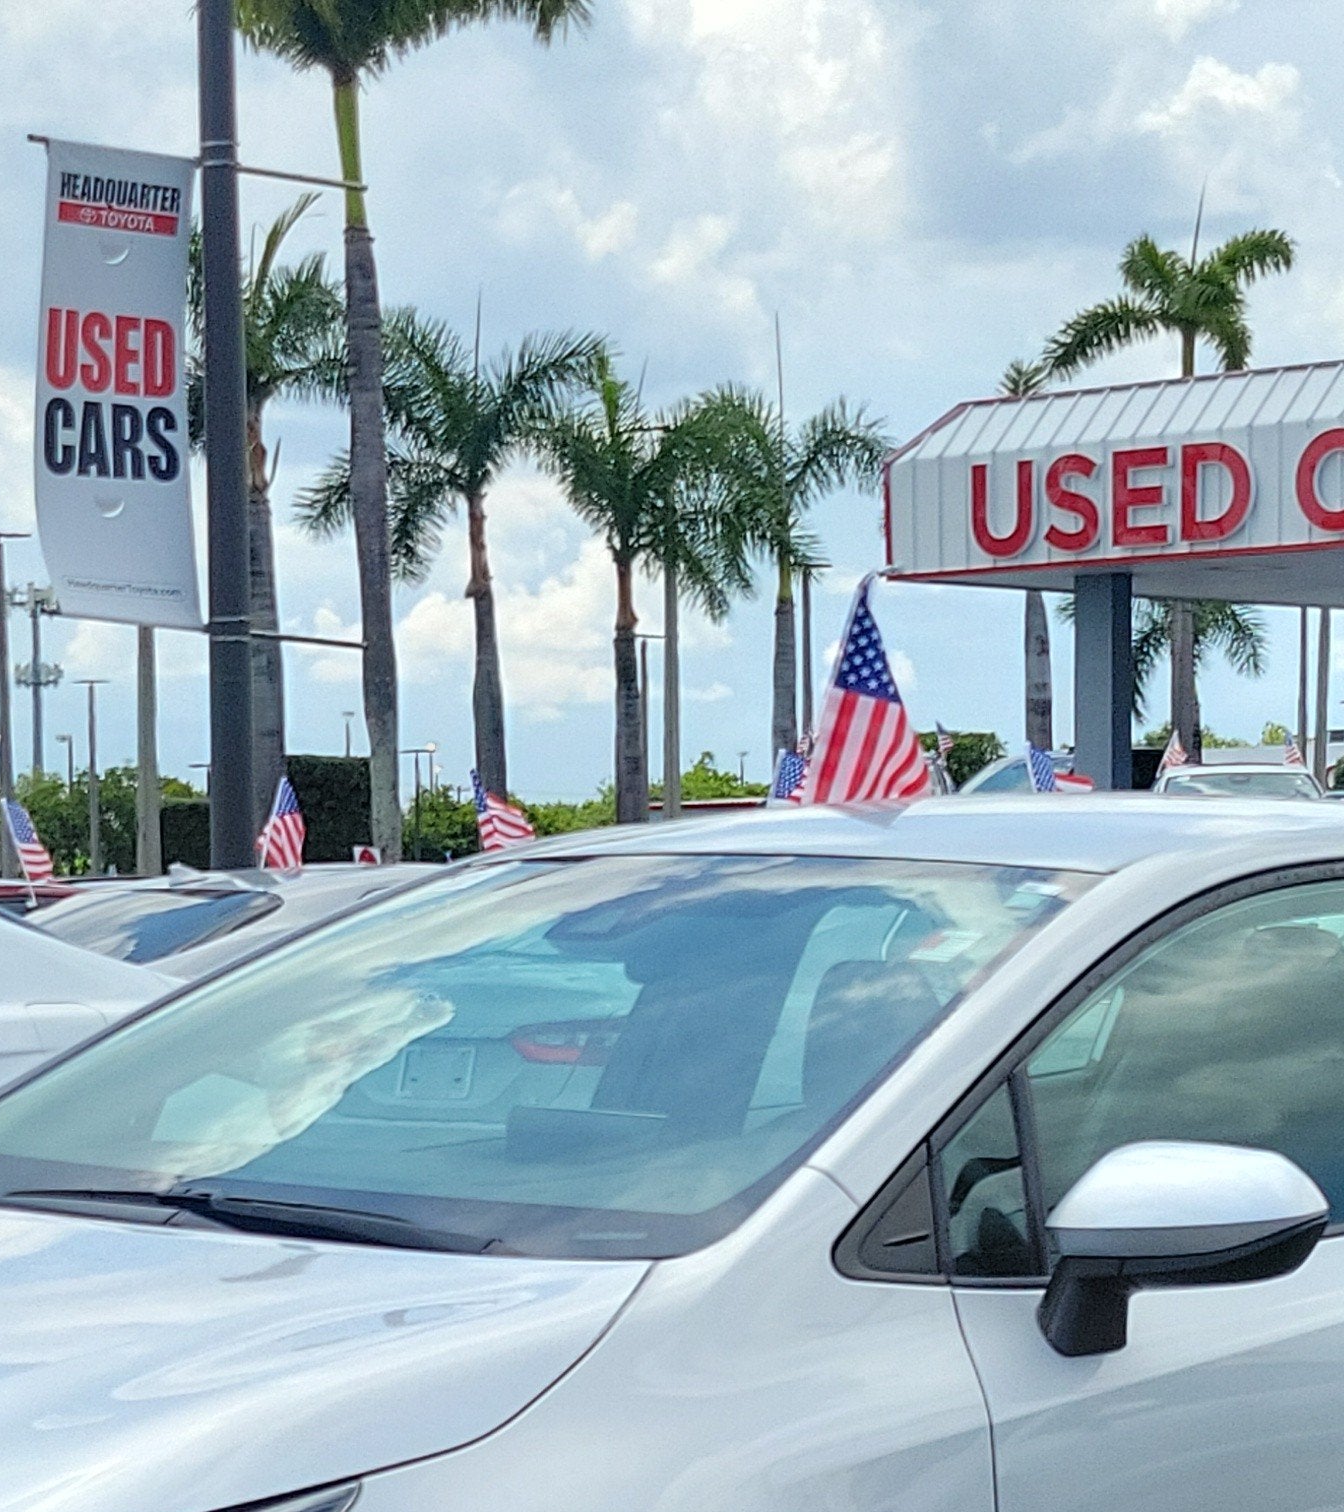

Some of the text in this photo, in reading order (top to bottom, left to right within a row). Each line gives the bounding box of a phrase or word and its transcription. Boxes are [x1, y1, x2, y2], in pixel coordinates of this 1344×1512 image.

[59, 171, 181, 213] HEADQUARTER
[100, 211, 155, 232] TOYOTA
[44, 307, 177, 399] USED
[43, 397, 181, 482] CARS
[970, 442, 1253, 560] USED
